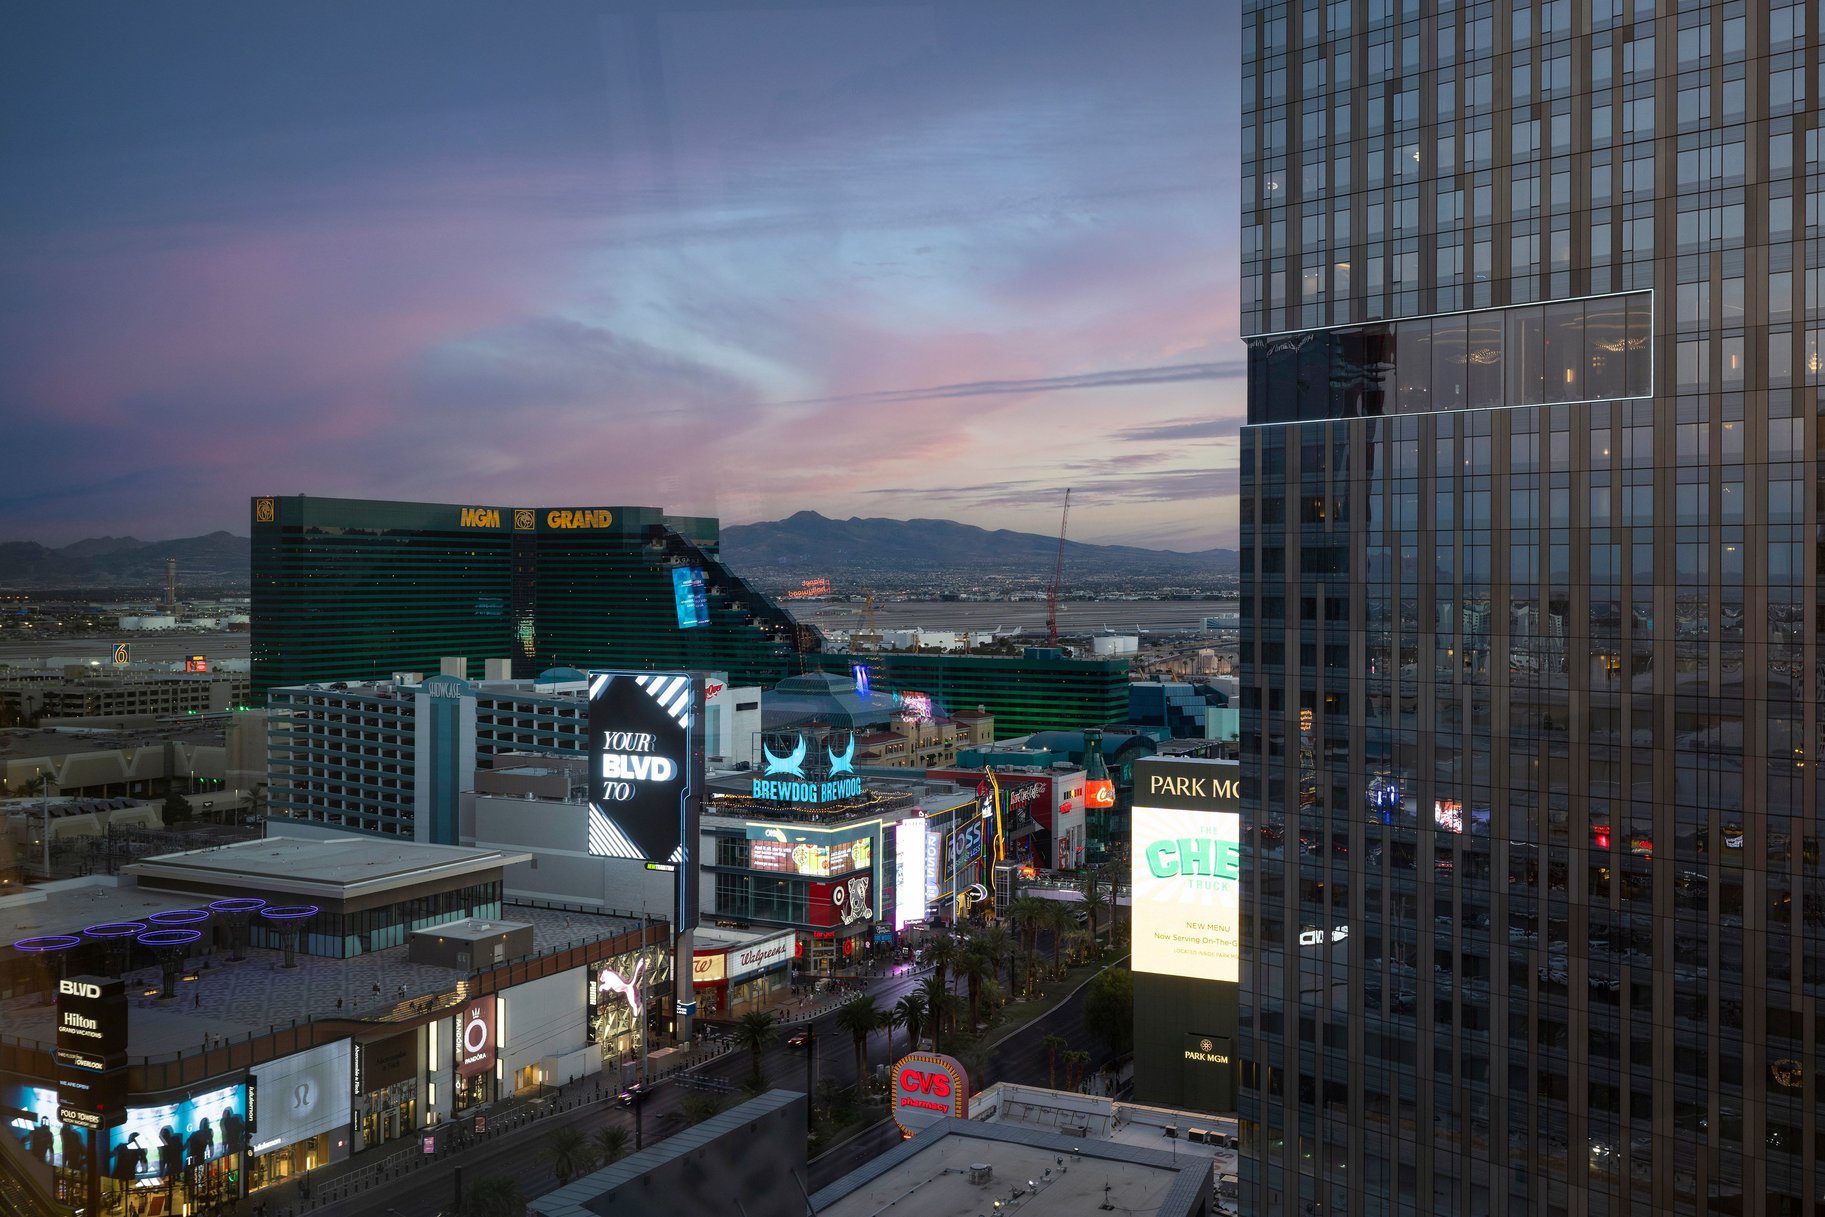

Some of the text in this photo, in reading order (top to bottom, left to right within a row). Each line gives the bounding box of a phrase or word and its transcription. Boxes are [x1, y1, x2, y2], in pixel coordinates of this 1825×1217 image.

[460, 508, 613, 529] MGM GRAND
[115, 643, 128, 664] 6
[428, 682, 463, 698] SHOWCASE
[602, 731, 654, 752] YOUR
[602, 753, 676, 781] BLVD
[602, 781, 633, 800] TO
[752, 779, 817, 803] BREWDOG
[821, 776, 861, 803] BREWDOG
[1151, 775, 1206, 797] PARK
[926, 836, 937, 878] ROSS
[1189, 879, 1229, 891] TRUCK
[1186, 922, 1231, 932] NEW MENU
[1154, 932, 1171, 941] Now
[1173, 933, 1201, 945] Serving
[741, 943, 786, 966] Walgreens
[59, 980, 101, 998] BLVD
[589, 981, 597, 1005] PUMA
[64, 1012, 97, 1030] Hilton
[58, 1026, 103, 1039] GRAND VACATIONS
[76, 1060, 103, 1070] OVERLOOK
[1184, 1051, 1229, 1064] PARK MGM
[900, 1069, 951, 1098] CVS
[901, 1097, 950, 1115] pharmacy
[60, 1109, 100, 1124] POLO TOWERS
